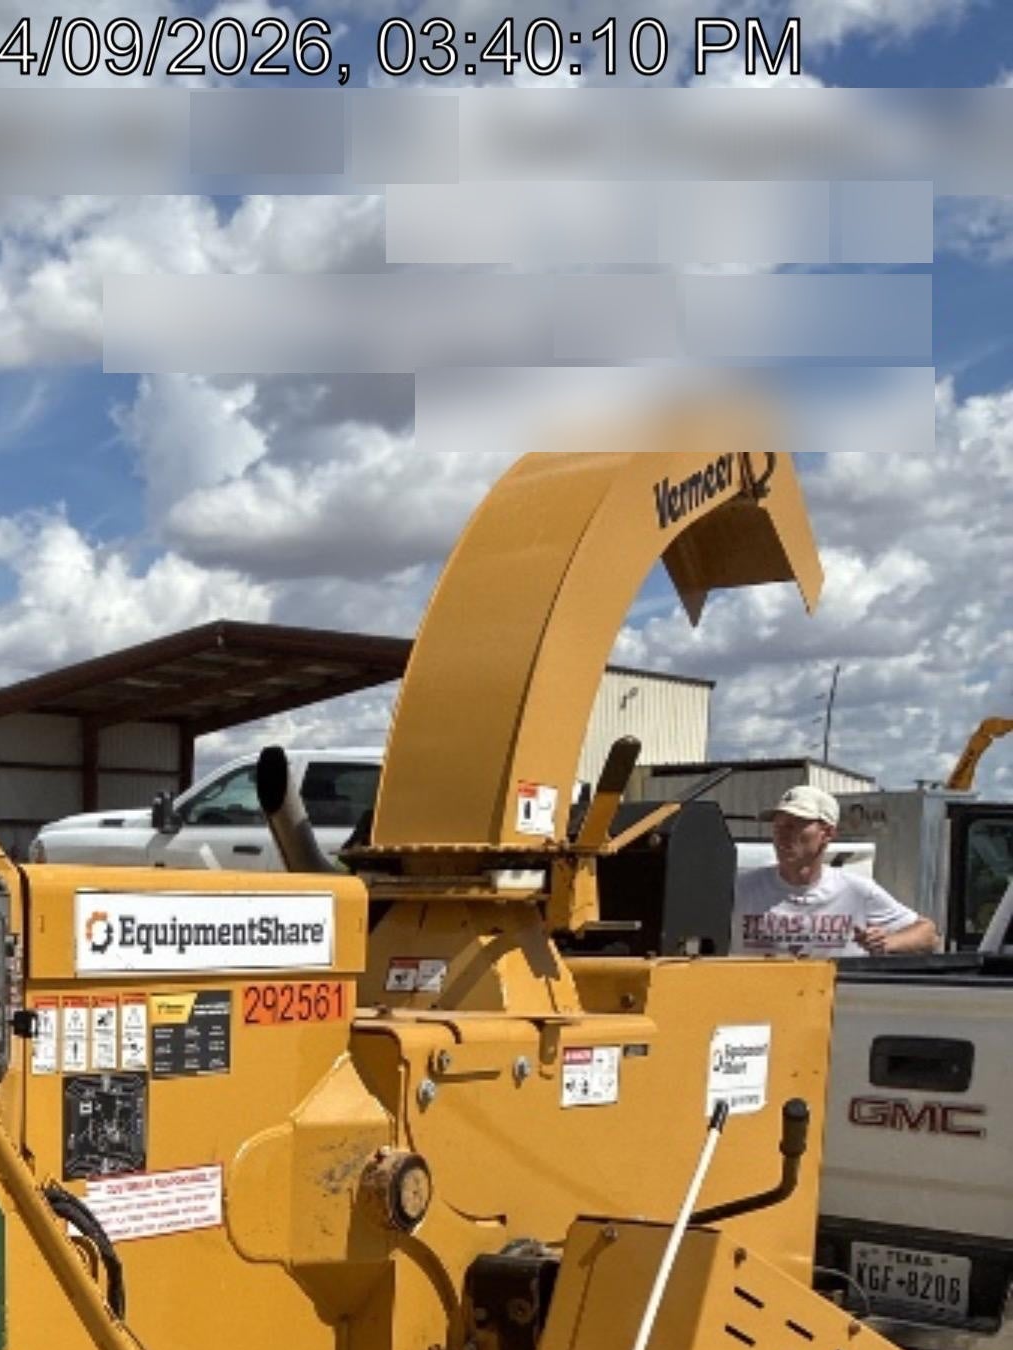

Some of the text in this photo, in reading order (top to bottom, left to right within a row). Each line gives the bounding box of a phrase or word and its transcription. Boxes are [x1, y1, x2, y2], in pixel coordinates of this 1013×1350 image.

[652, 452, 733, 529] Vermeer
[118, 914, 324, 955] EquipmentShare
[244, 983, 343, 1025] 292561
[848, 1096, 986, 1138] GMC
